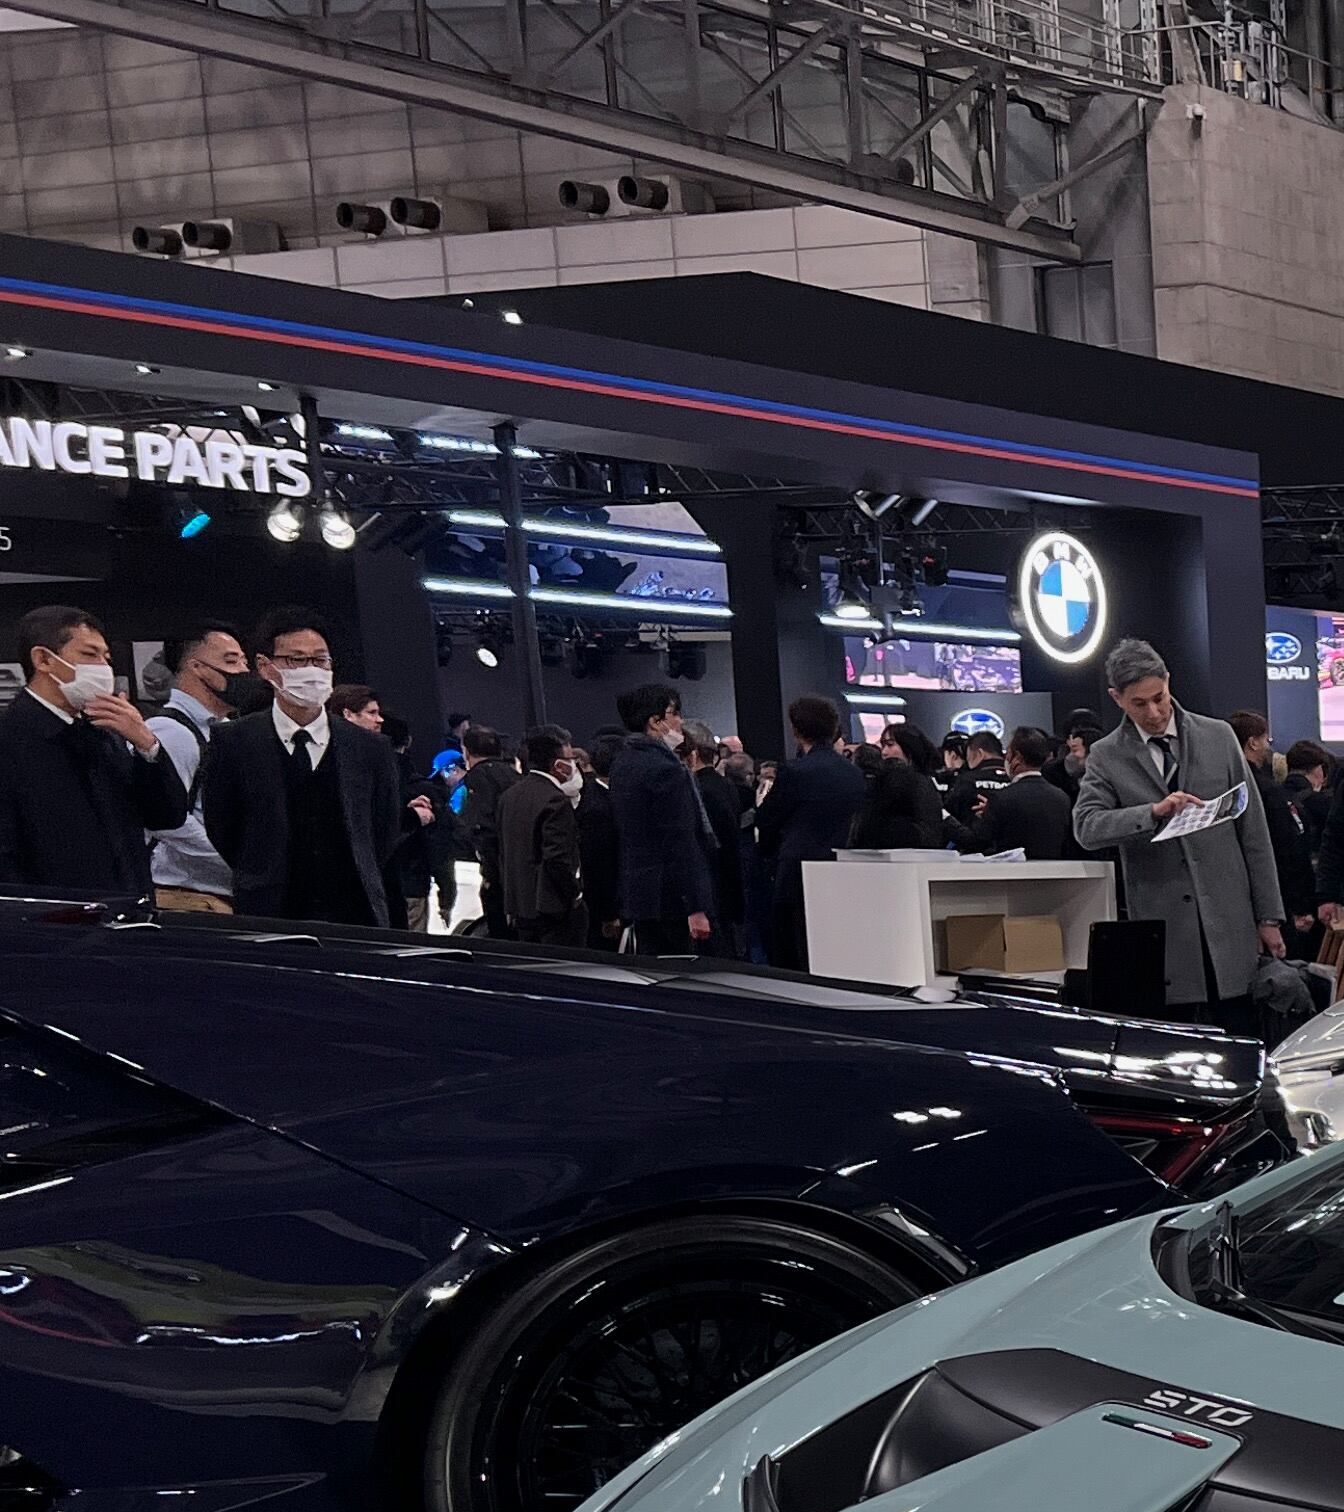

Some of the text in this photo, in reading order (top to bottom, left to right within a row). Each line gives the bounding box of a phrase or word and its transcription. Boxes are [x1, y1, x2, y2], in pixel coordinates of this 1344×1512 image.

[133, 430, 311, 497] PARTS
[1266, 666, 1310, 681] BARU
[1144, 1389, 1253, 1427] STO
